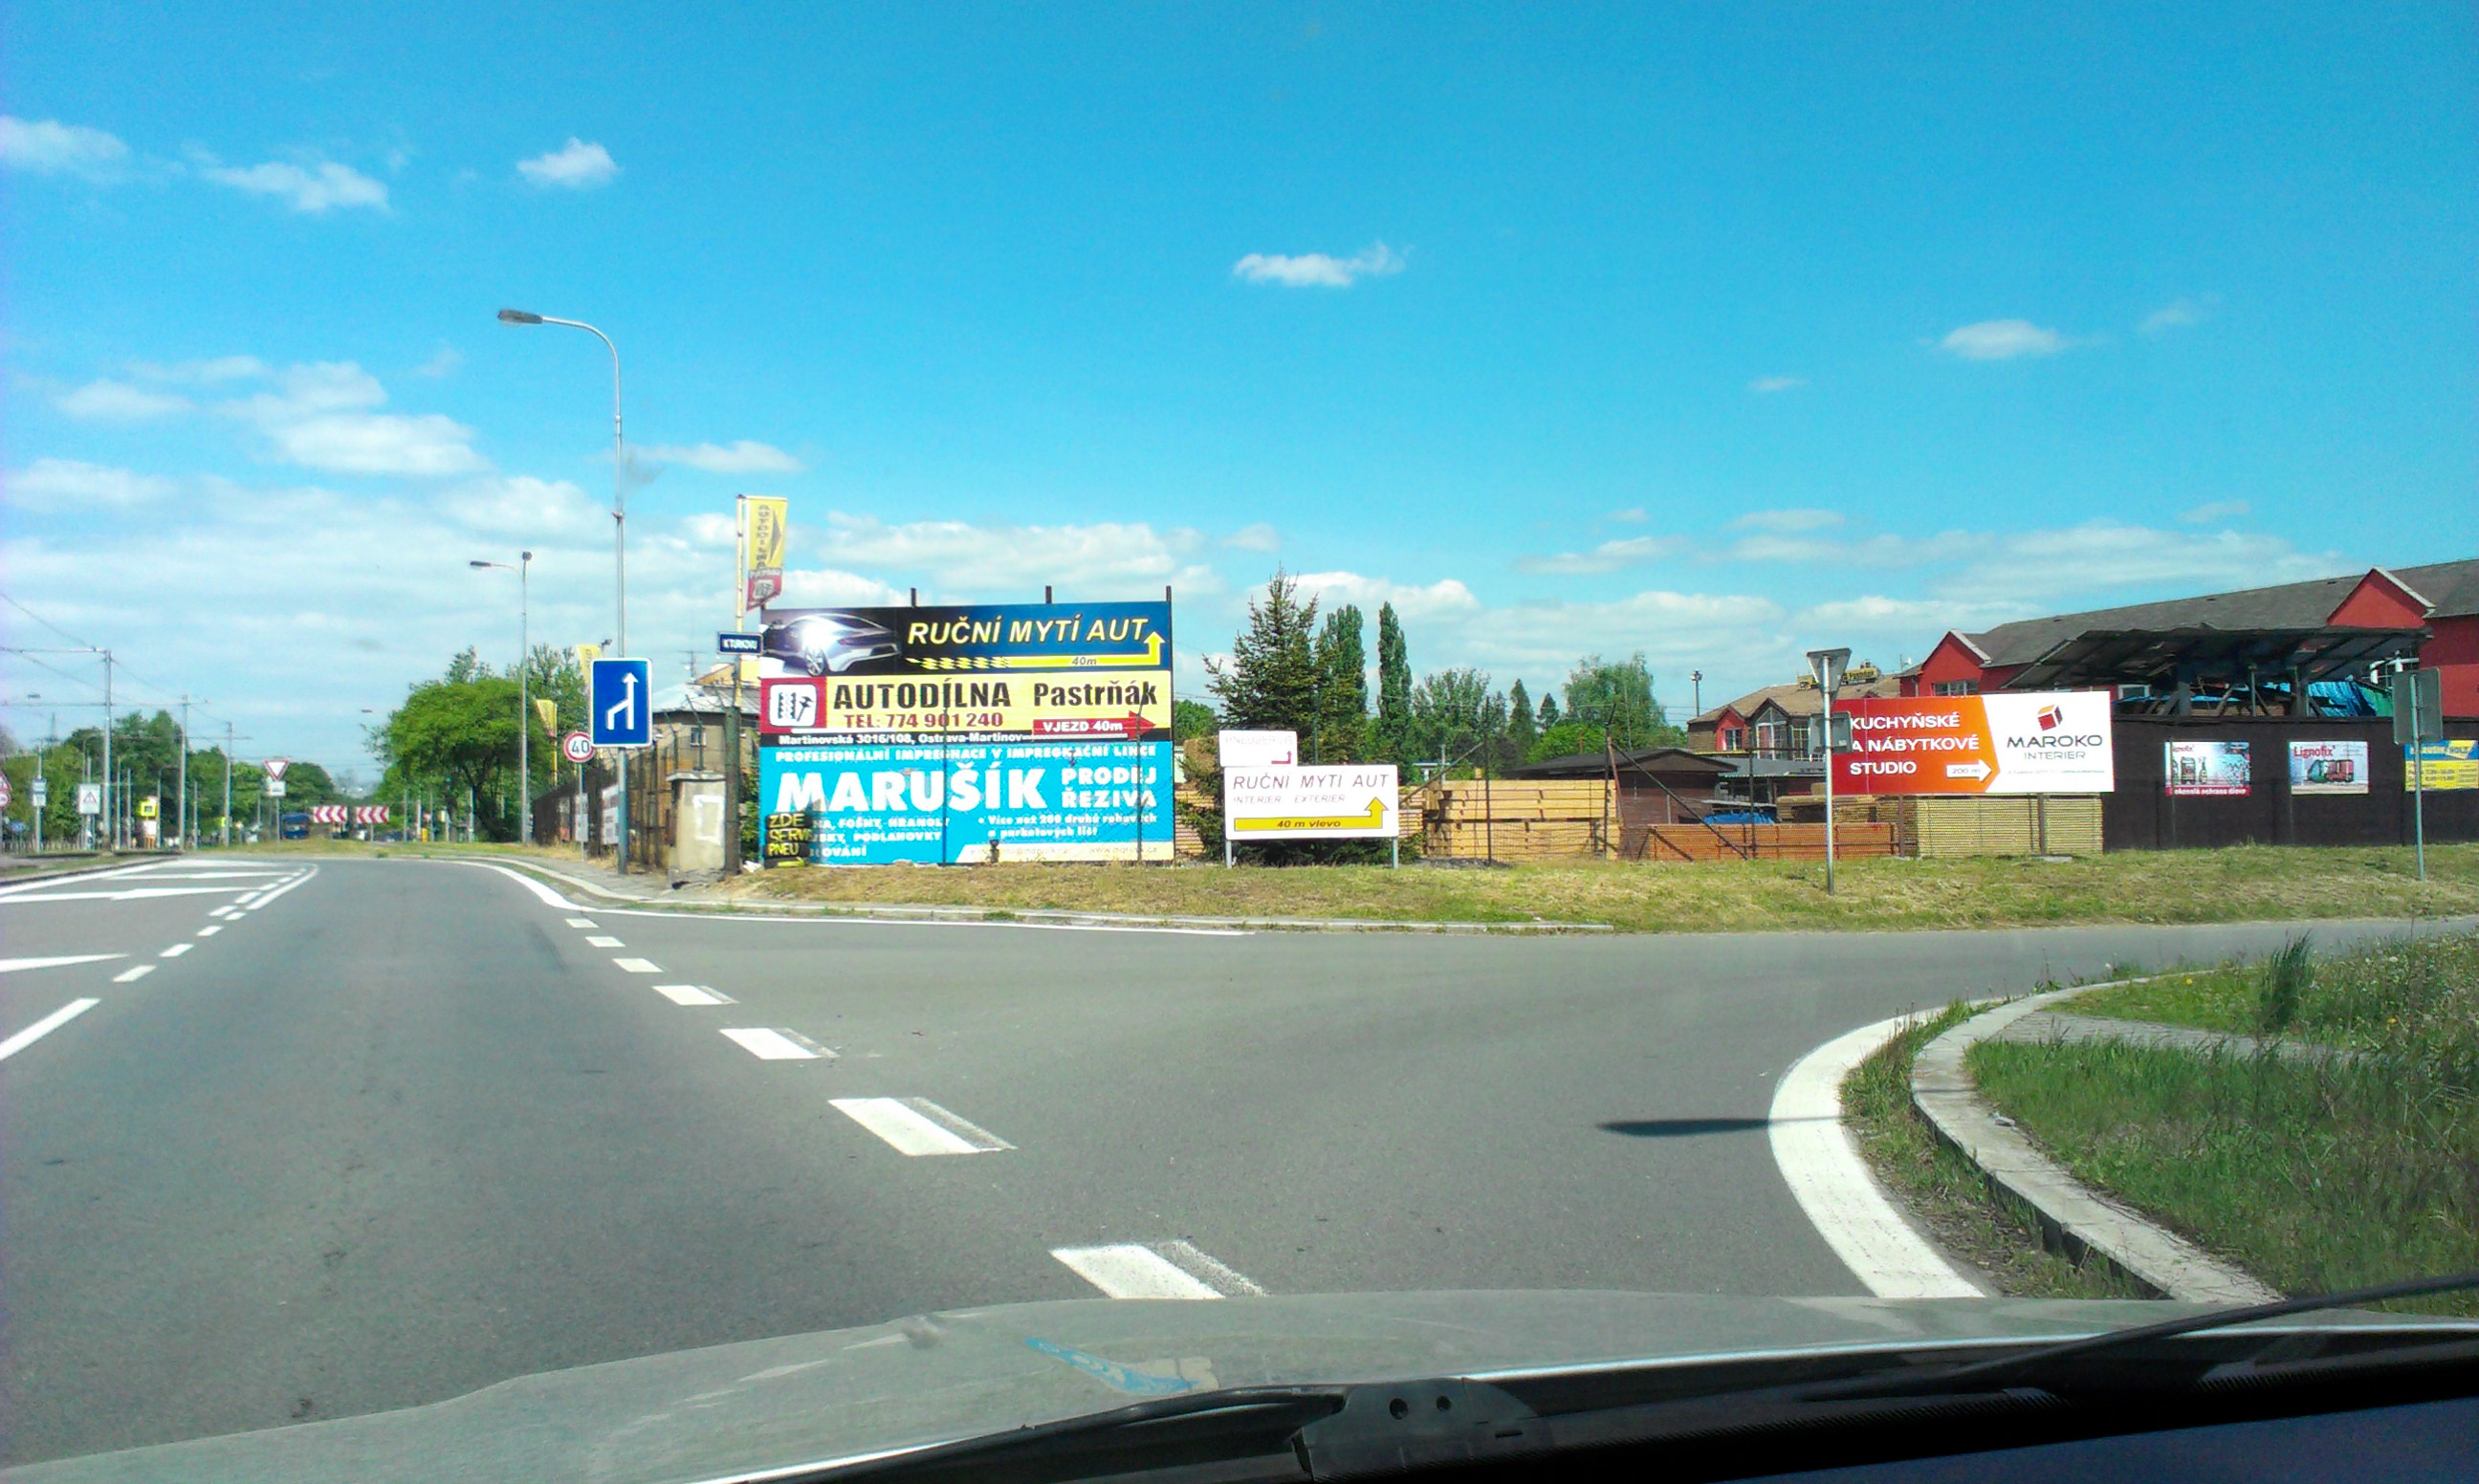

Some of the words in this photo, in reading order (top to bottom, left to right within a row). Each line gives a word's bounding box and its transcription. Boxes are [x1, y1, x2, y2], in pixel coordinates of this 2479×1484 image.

[908, 615, 1003, 645] RUČNÍ
[1008, 613, 1082, 644] MYTÍ
[1086, 618, 1150, 642] AUT
[1071, 657, 1098, 666] 40m
[833, 678, 1012, 709] AUTODÍLNA
[1033, 680, 1158, 708] Pastrňák
[844, 714, 880, 729] TEL:
[886, 713, 918, 729] 774
[924, 713, 960, 728] 901
[966, 712, 1003, 728] 240
[1042, 720, 1087, 732] VJEZD
[1092, 720, 1124, 732] 40m
[1850, 712, 1961, 731] KUCHYŇSKÉ
[571, 739, 591, 753] 40
[779, 733, 854, 746] Martinovská
[1852, 740, 1865, 753] A
[1868, 734, 1980, 753] NÁBYTKOVÉ
[2007, 733, 2104, 749] MAROKO
[775, 748, 890, 762] PROFESIONÁLNÍ
[895, 747, 986, 761] IMPREGNACE
[991, 748, 1002, 758] V
[1007, 744, 1109, 758] IMPREGNAČNÍ
[2024, 751, 2086, 761] INTERIER
[2293, 745, 2334, 759] Lignofix
[1850, 759, 1918, 776] STUDIO
[775, 761, 1048, 812] MARUŠÍK
[1352, 774, 1391, 789] AUT
[1061, 786, 1157, 808] ŘEZIVA
[768, 813, 805, 828] ZDE
[1277, 820, 1291, 829] 40
[1308, 820, 1342, 829] vlevo
[768, 842, 800, 857] PNEU
